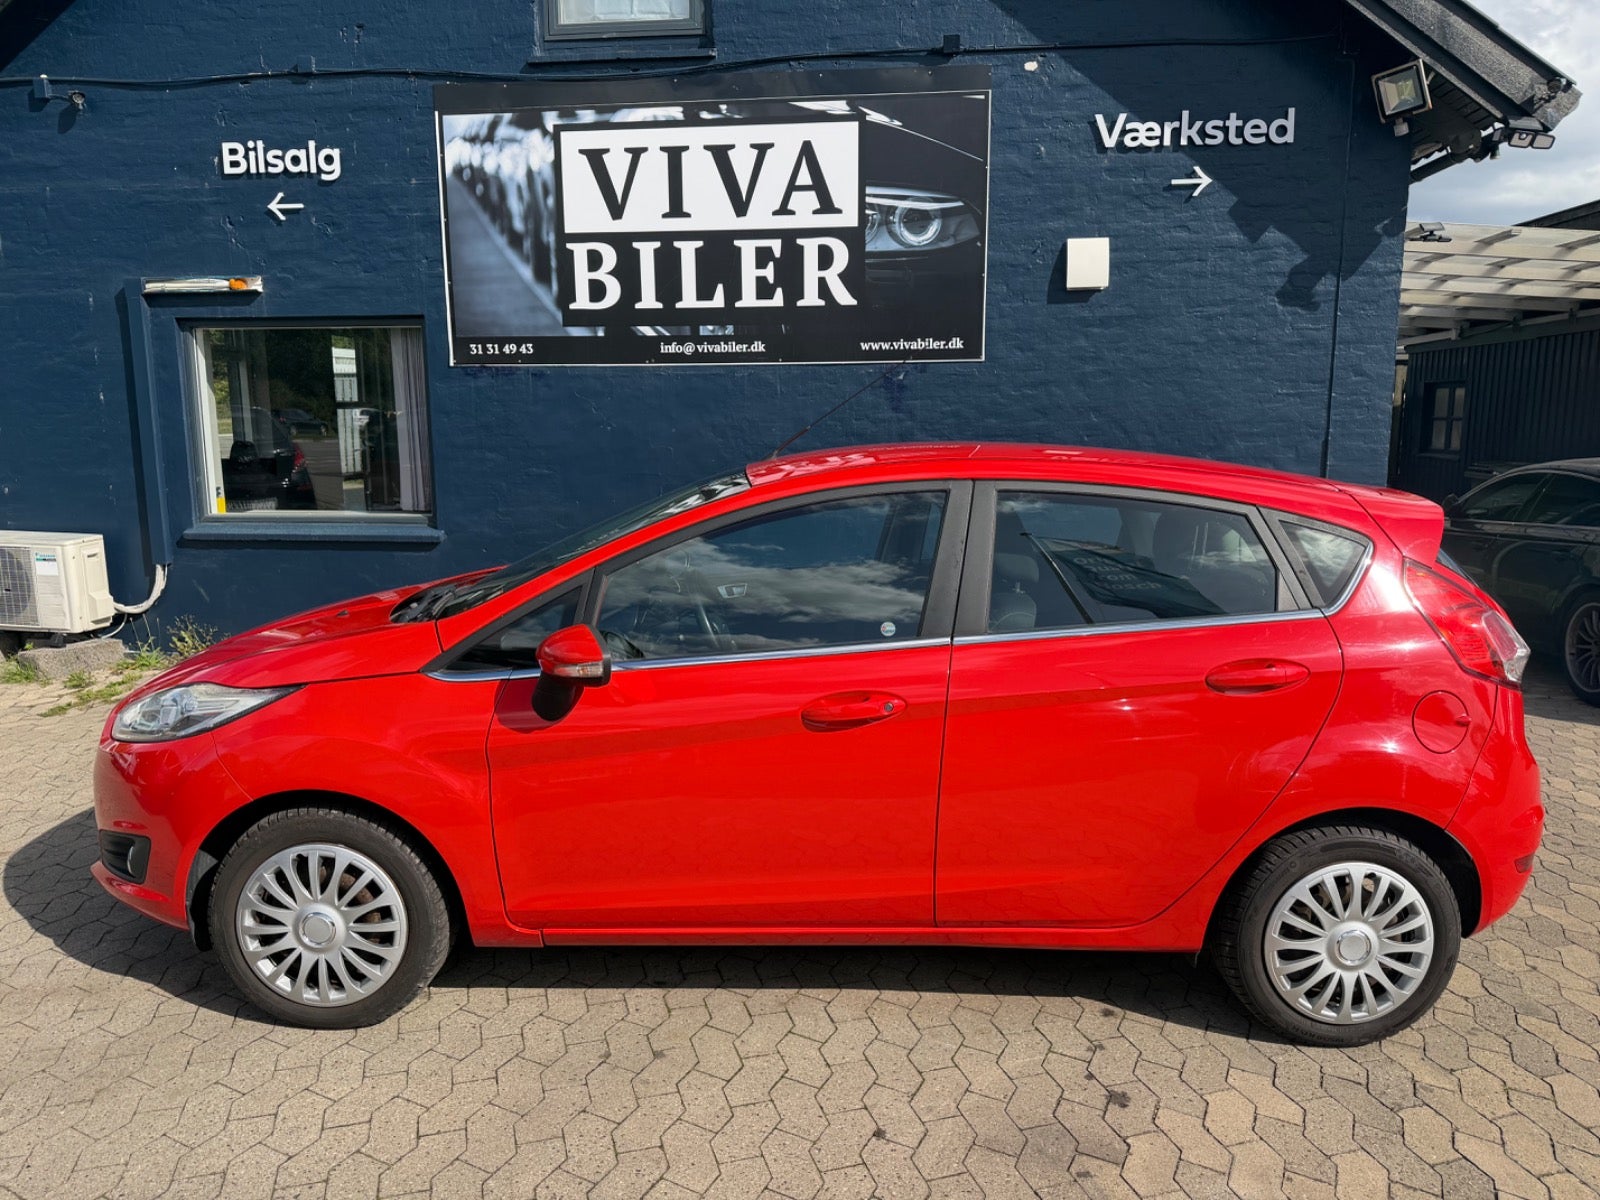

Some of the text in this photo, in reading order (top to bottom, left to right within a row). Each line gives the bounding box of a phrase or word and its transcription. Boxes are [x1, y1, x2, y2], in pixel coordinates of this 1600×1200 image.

[1094, 107, 1296, 148] Værksted
[221, 139, 341, 181] Bilsalg
[578, 140, 843, 221] VIVA
[565, 236, 858, 310] BILER
[469, 343, 534, 355] 31 31 49 43
[860, 337, 964, 351] www.vivabiler.dk
